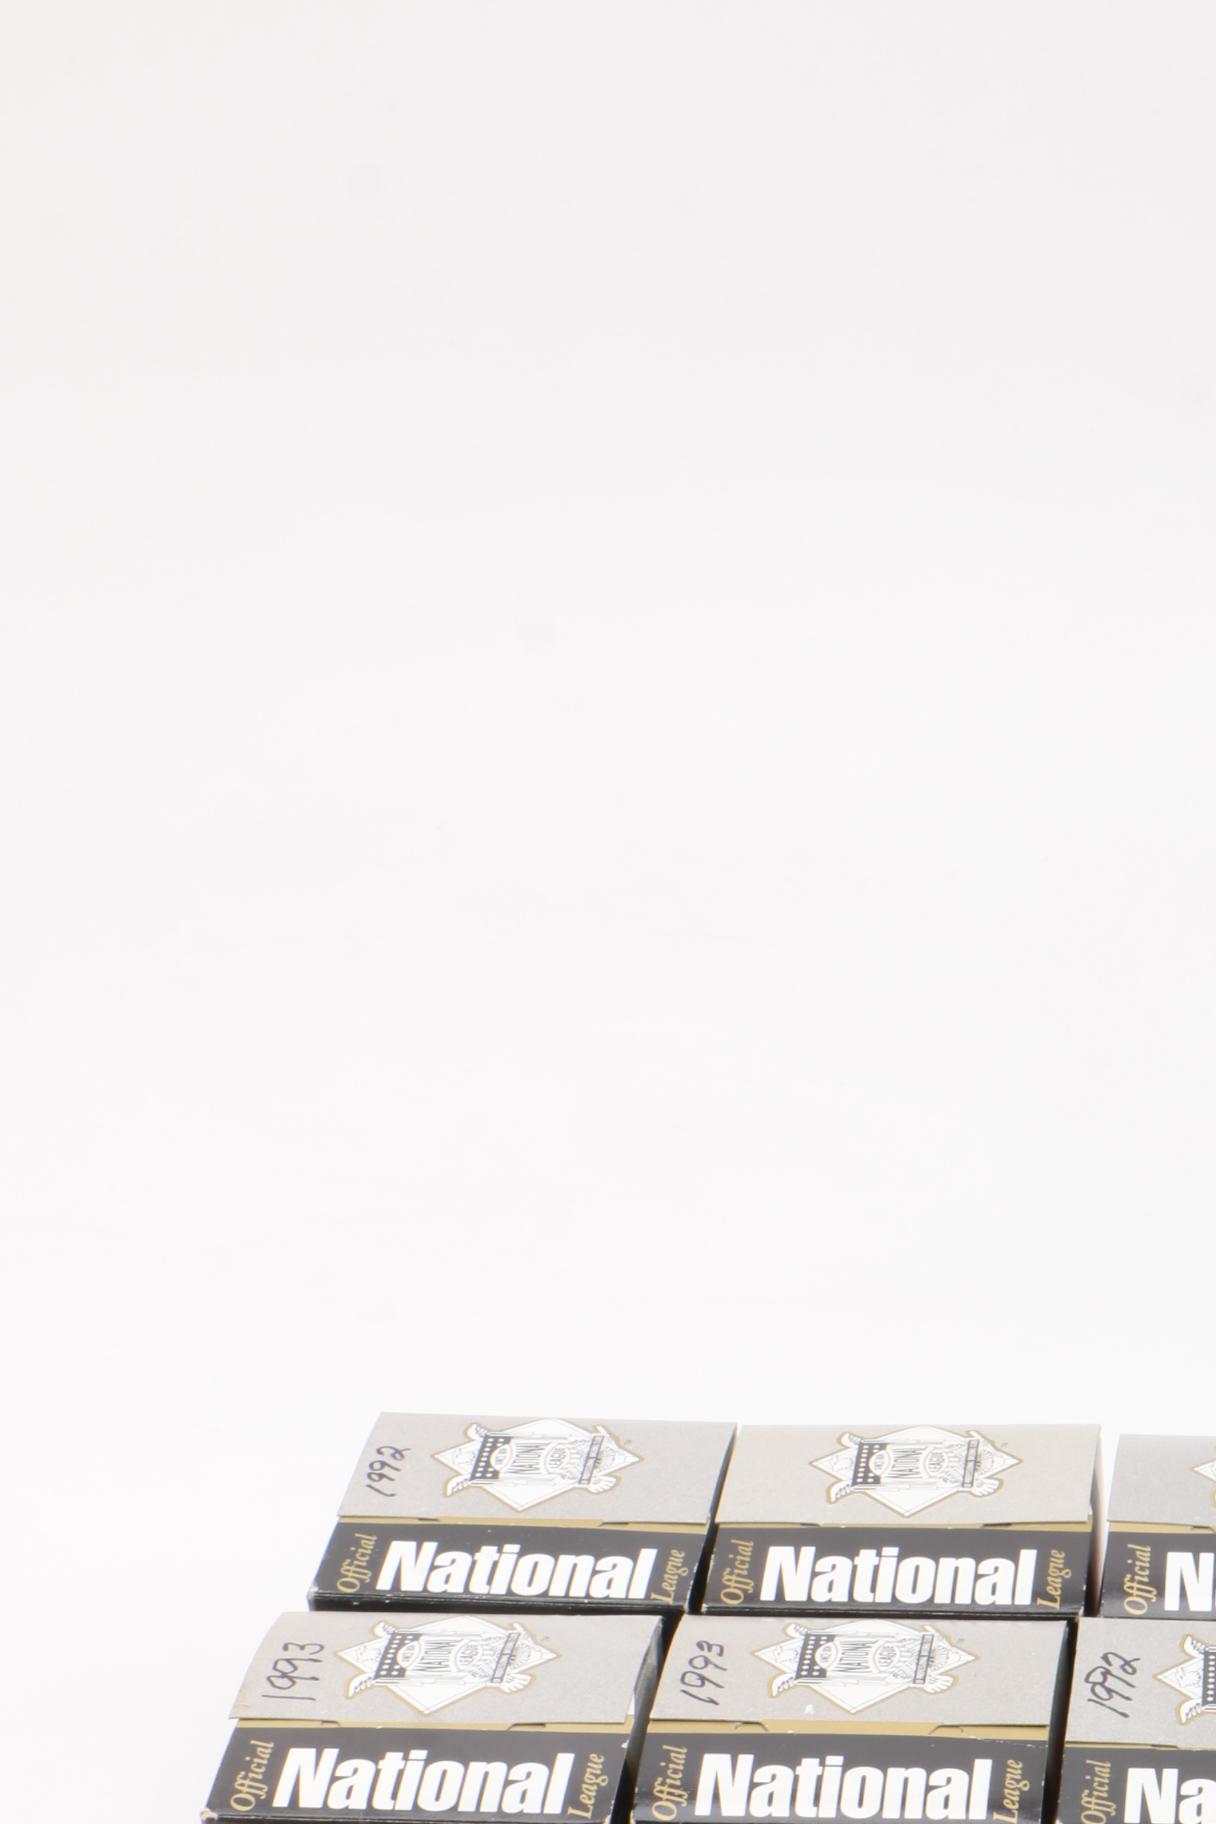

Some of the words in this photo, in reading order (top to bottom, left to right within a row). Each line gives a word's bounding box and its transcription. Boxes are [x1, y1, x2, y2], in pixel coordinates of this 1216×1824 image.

[365, 1445, 412, 1498] 1992
[336, 1533, 378, 1594] Official
[376, 1541, 658, 1600] National
[650, 1549, 688, 1603] League
[719, 1540, 755, 1606] Official
[759, 1545, 1038, 1607] National
[1037, 1549, 1070, 1611] League
[1123, 1544, 1156, 1616] Official
[261, 1641, 325, 1701] 1993
[680, 1640, 729, 1706] 1993
[1087, 1651, 1141, 1718] 1992
[230, 1740, 275, 1812] Official
[272, 1747, 576, 1815] National
[567, 1753, 610, 1820] League
[652, 1745, 689, 1822] Official
[694, 1753, 993, 1821] National
